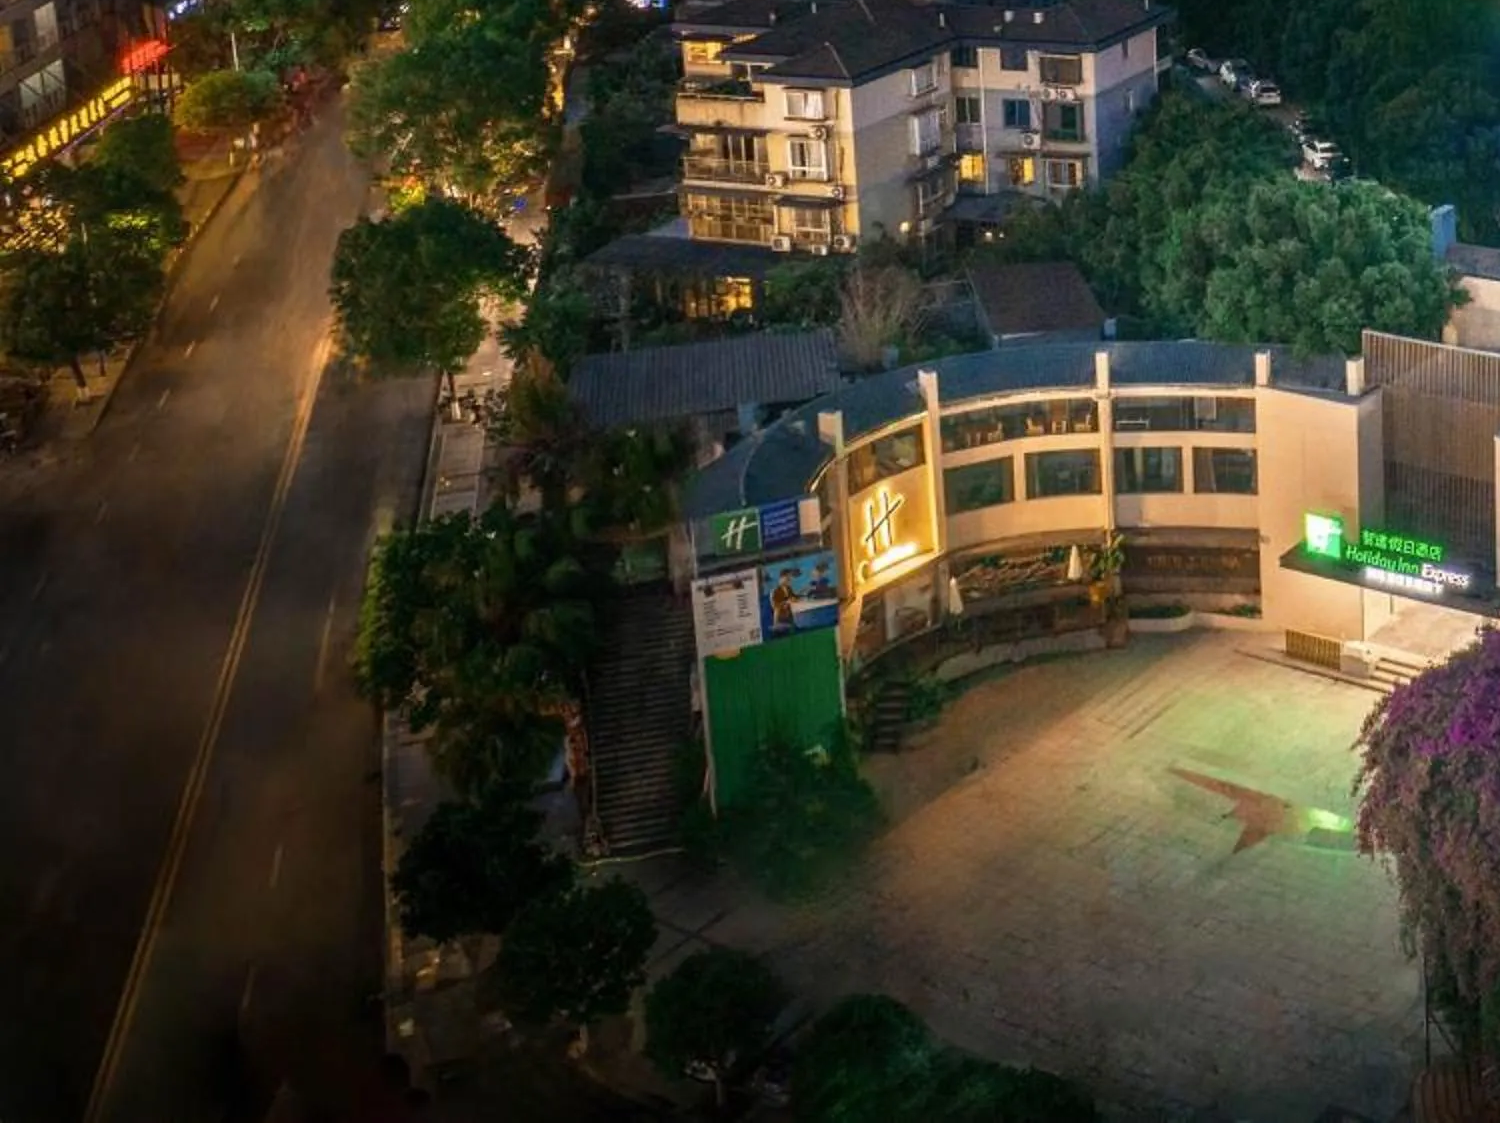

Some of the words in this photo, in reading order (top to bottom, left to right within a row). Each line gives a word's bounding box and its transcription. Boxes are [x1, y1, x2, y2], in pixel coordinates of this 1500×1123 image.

[1345, 543, 1397, 575] Holiday
[1397, 557, 1419, 575] Inn
[1421, 563, 1470, 589] Express
